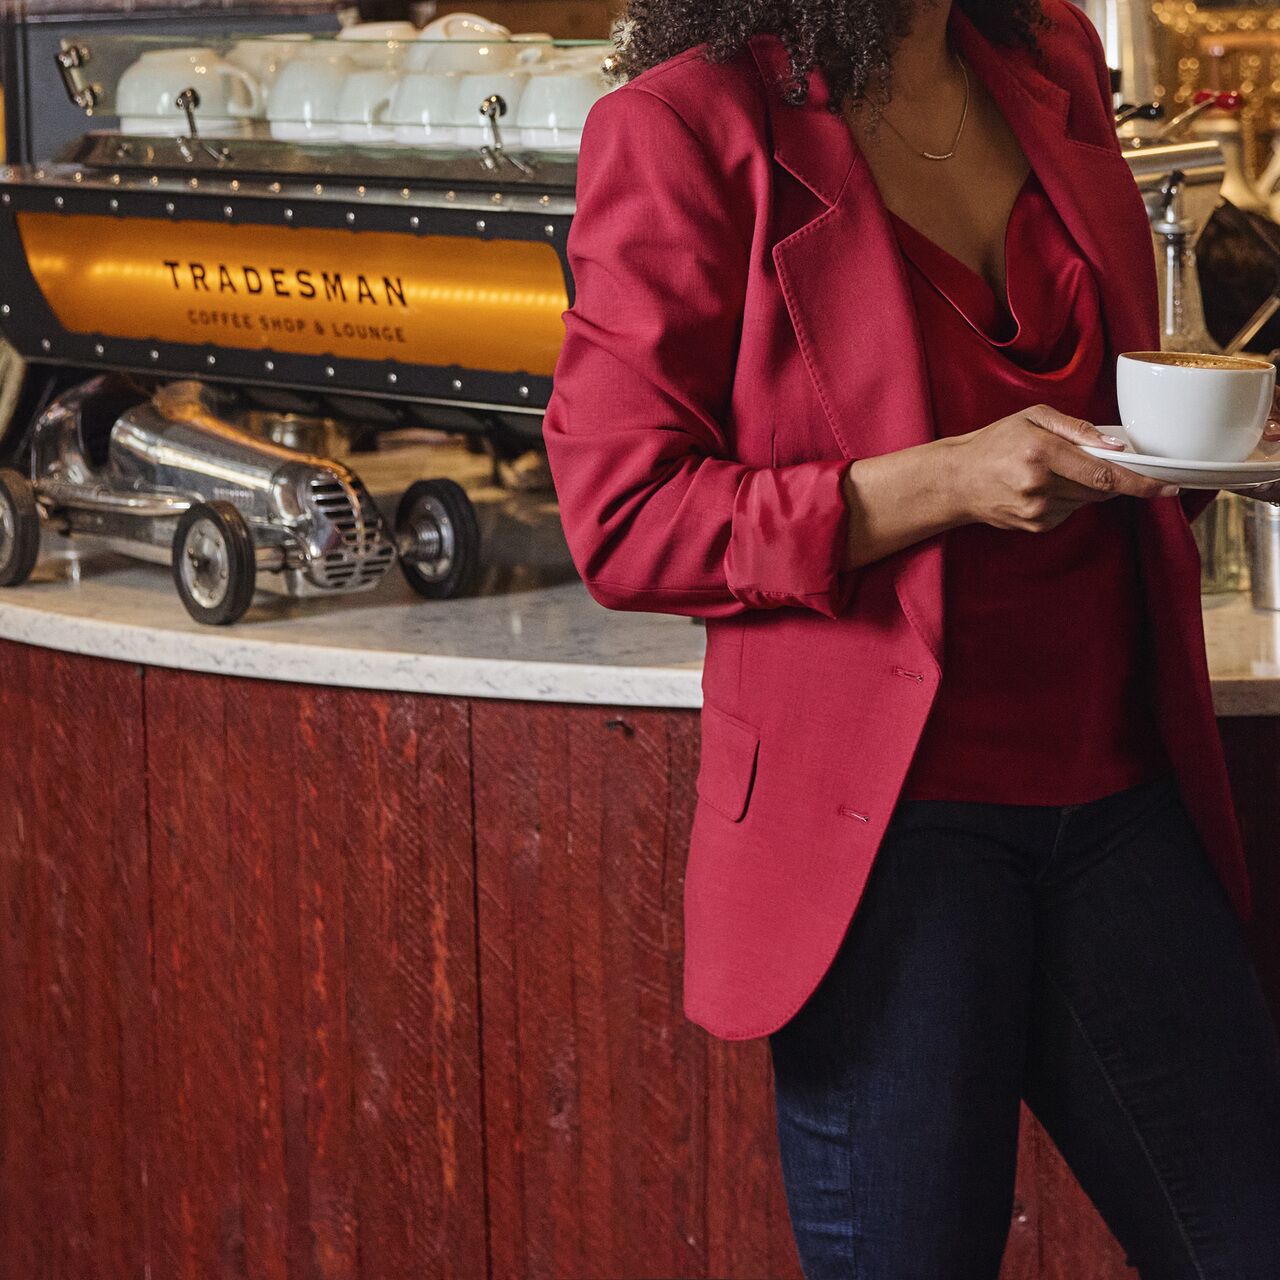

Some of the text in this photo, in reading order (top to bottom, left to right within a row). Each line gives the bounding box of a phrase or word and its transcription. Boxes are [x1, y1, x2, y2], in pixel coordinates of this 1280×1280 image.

[163, 260, 407, 307] TRADESMAN
[187, 309, 405, 343] COFFEE SHOP & LOUNGE
